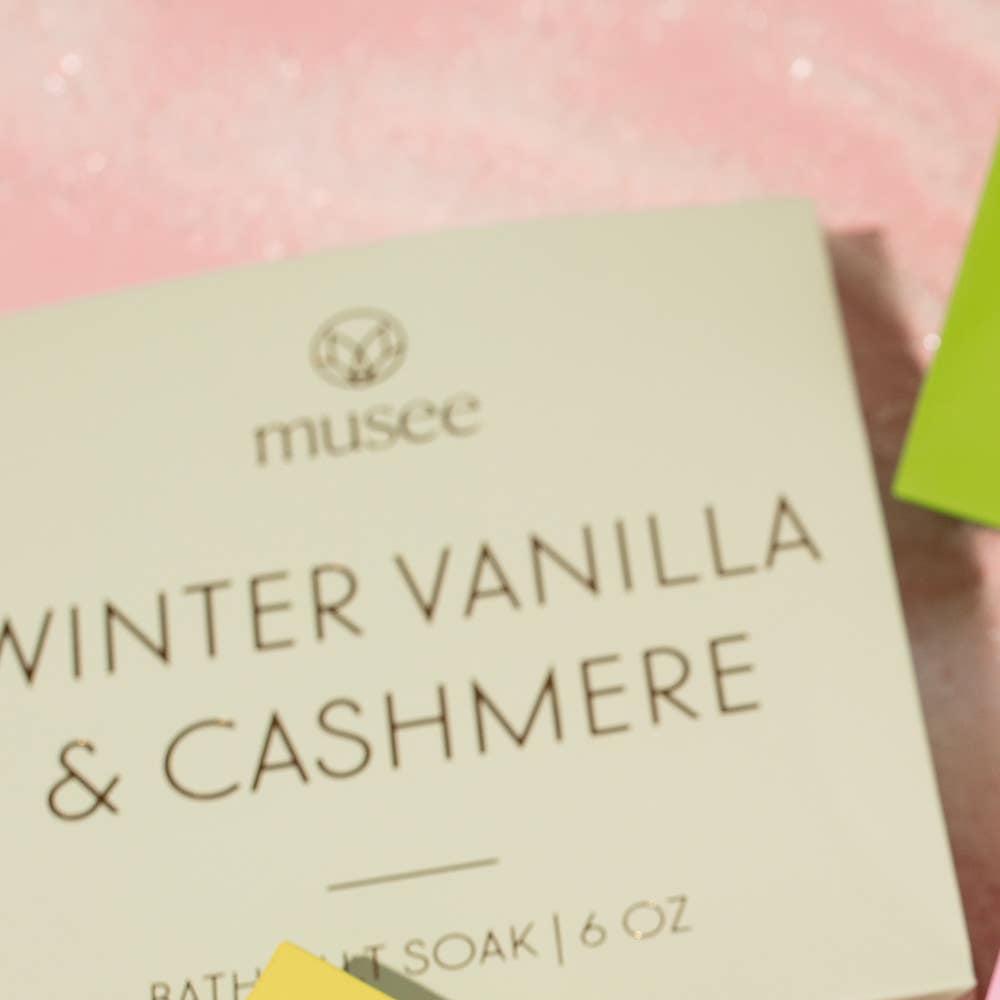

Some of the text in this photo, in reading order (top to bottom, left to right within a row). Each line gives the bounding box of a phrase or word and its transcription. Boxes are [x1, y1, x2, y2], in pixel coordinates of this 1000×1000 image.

[252, 391, 484, 466] musee
[394, 493, 824, 624] VANILLA
[47, 632, 761, 822] & CASHMERE
[403, 920, 540, 977] SOAK
[580, 911, 608, 949] 6
[621, 895, 692, 940] OZ
